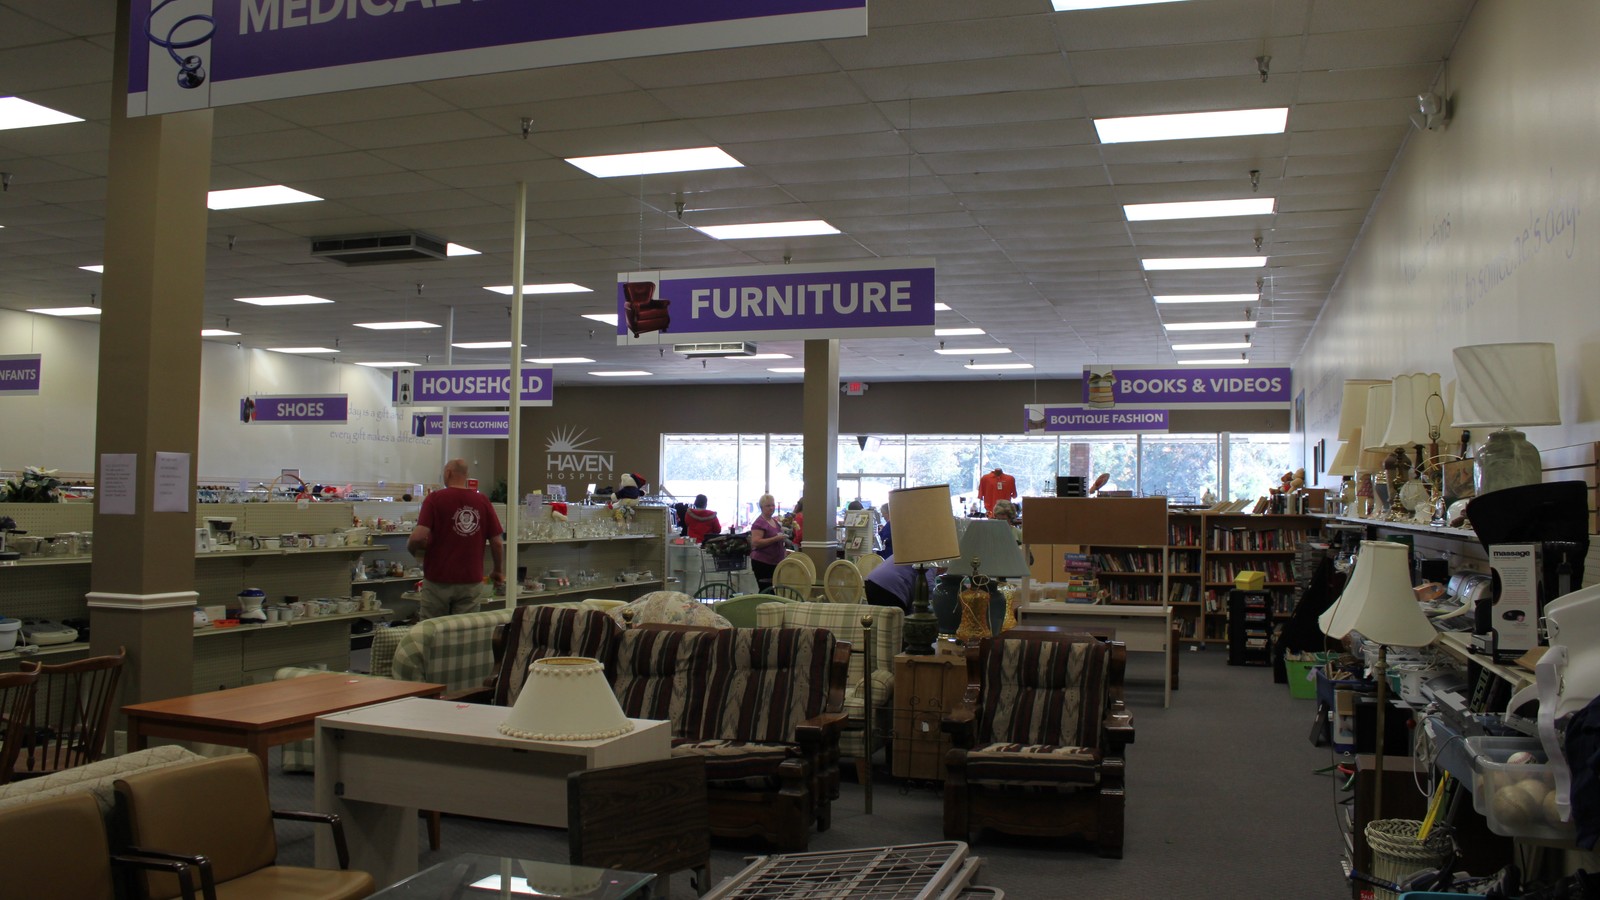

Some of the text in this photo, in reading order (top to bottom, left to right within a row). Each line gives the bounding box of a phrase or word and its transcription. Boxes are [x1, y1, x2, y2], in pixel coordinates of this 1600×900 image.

[239, 0, 460, 35] MEDI
[691, 281, 912, 319] FURNITURE
[422, 376, 543, 395] HOUSEHOLD
[1120, 377, 1282, 394] BOOKS & VIDEOS
[277, 403, 324, 417] SHOES
[430, 421, 509, 429] WOEN'S CLOTHING
[1050, 413, 1164, 425] BOUTIQUE FASHION
[329, 430, 351, 444] every
[352, 427, 366, 444] gift
[547, 454, 614, 472] HAVEN
